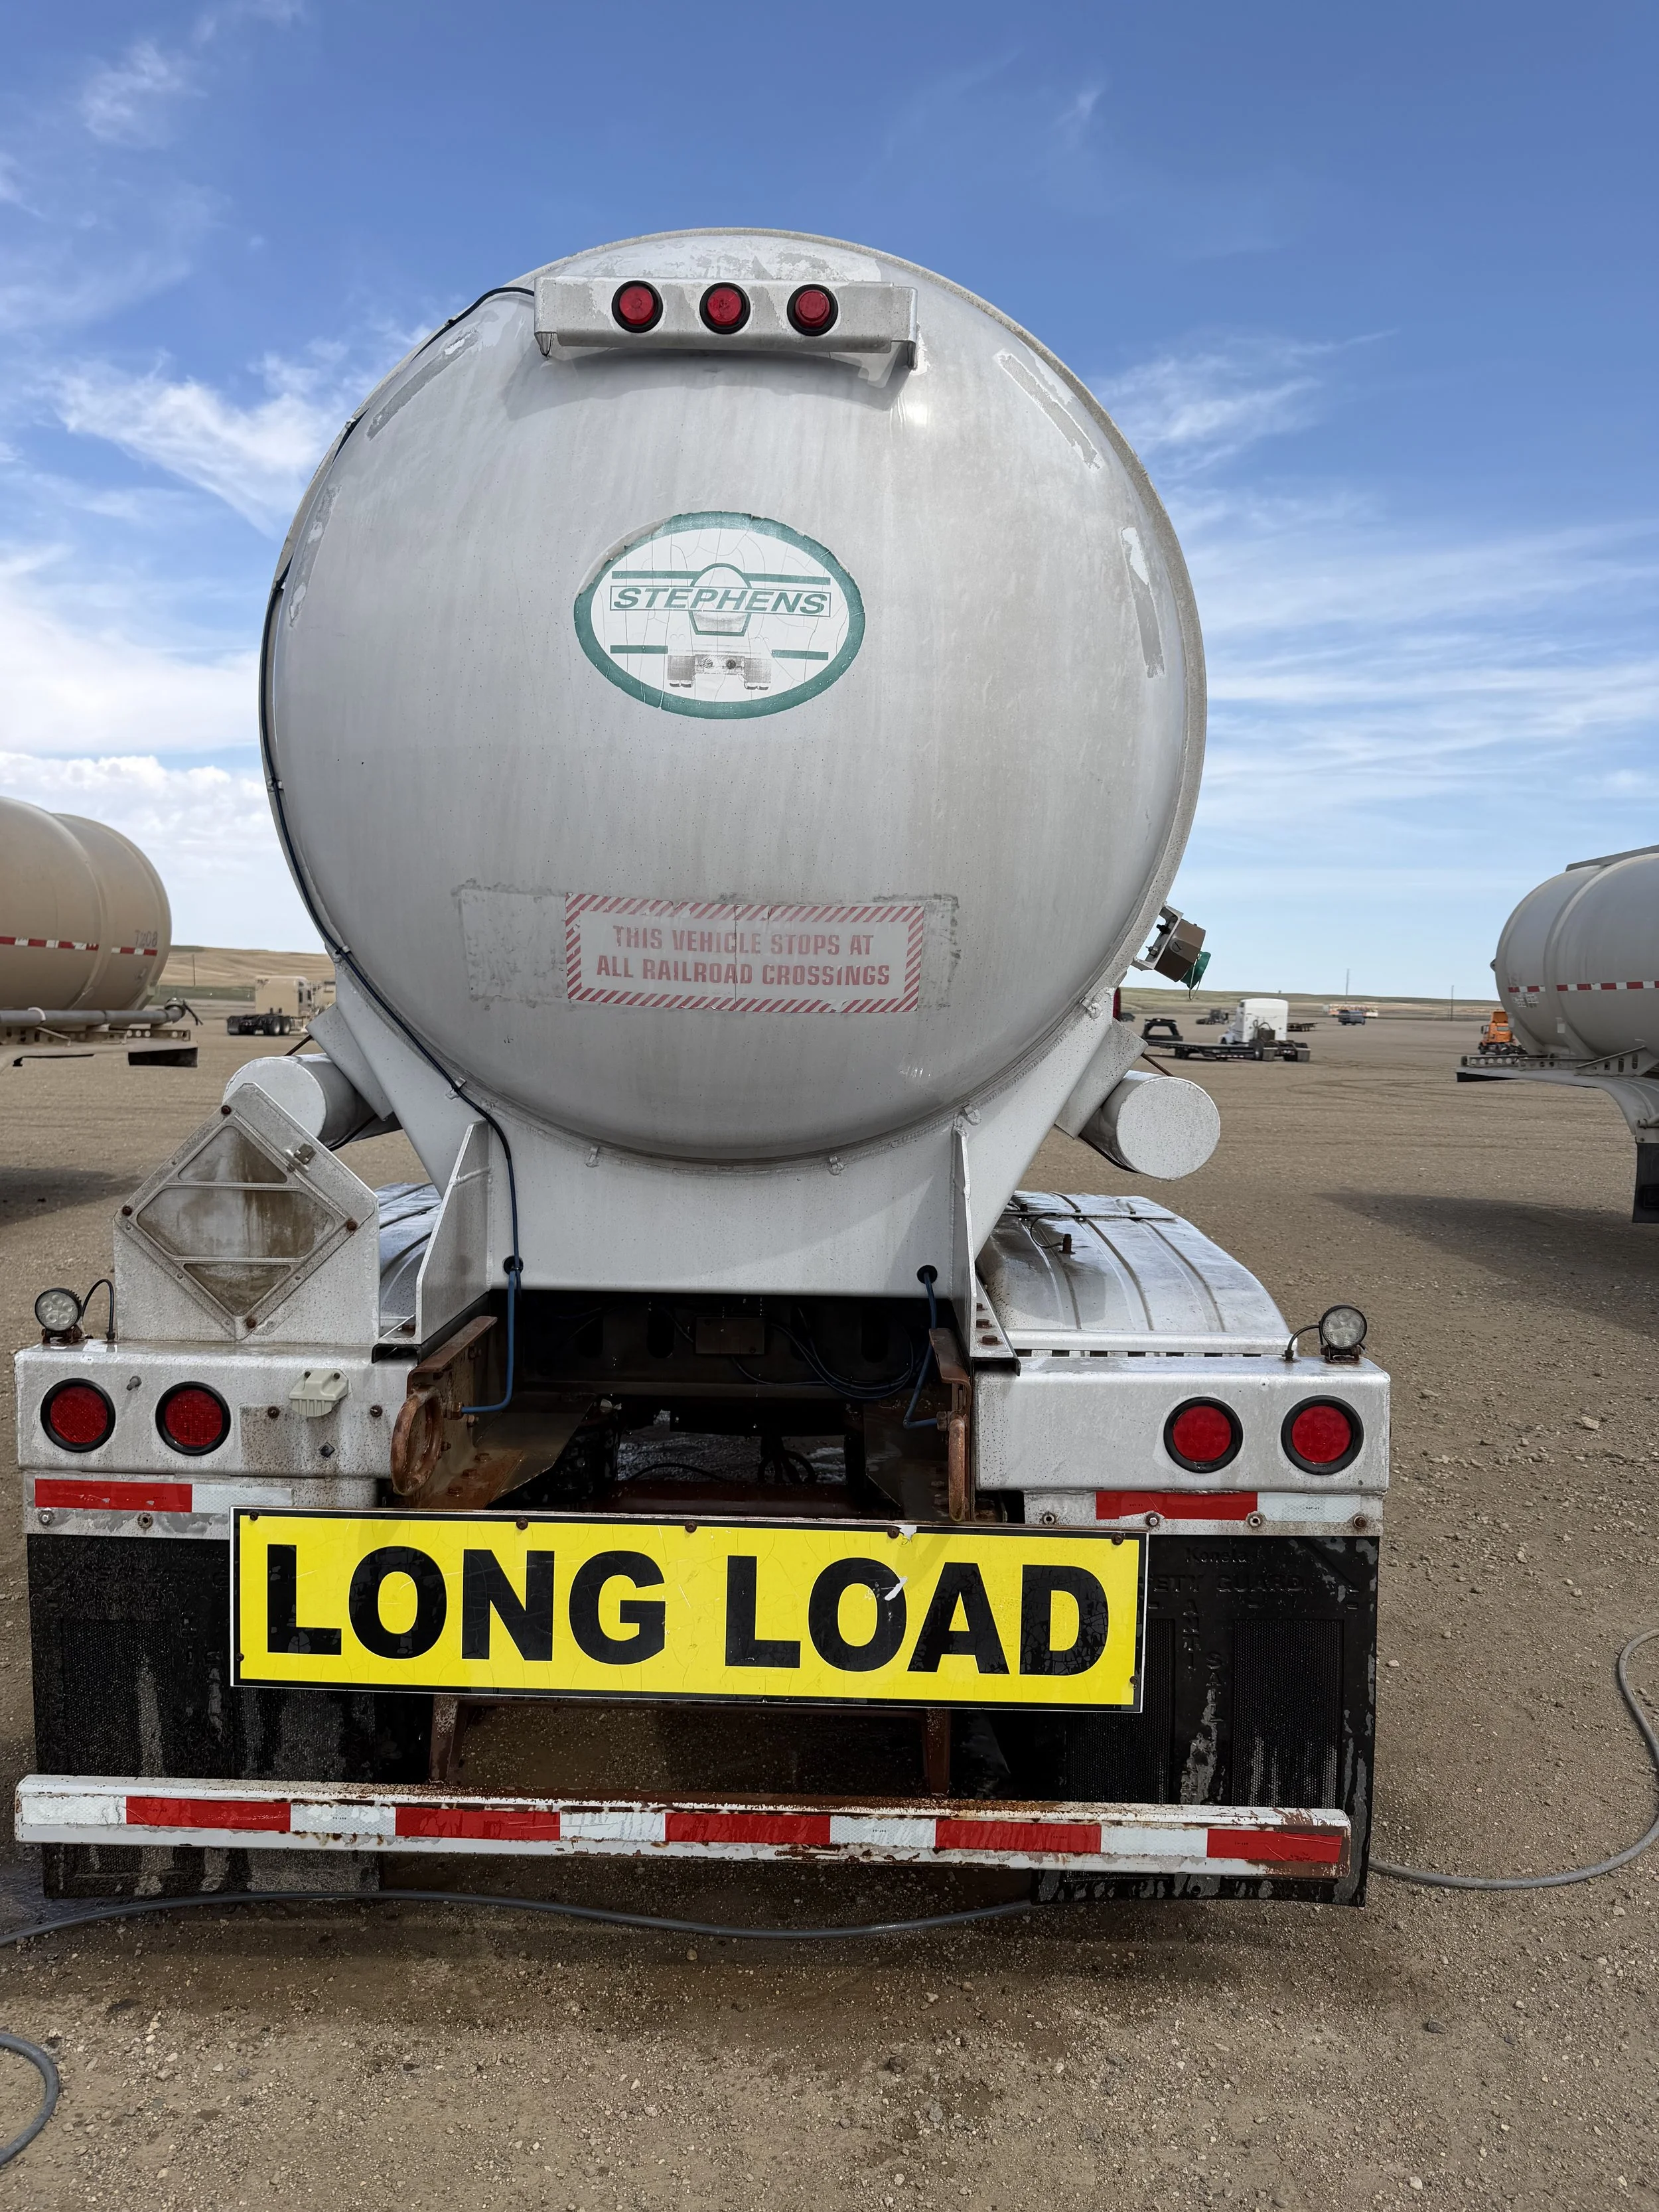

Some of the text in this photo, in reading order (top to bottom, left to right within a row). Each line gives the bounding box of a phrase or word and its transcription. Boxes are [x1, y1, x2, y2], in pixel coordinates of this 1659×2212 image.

[613, 587, 828, 615] STEPHENS
[613, 925, 874, 956] THIS VEHICLE STOPS AT
[596, 955, 890, 986] ALL RAILROAD CROSSINGS
[266, 1544, 667, 1665] LONG
[725, 1555, 1109, 1676] LOAD
